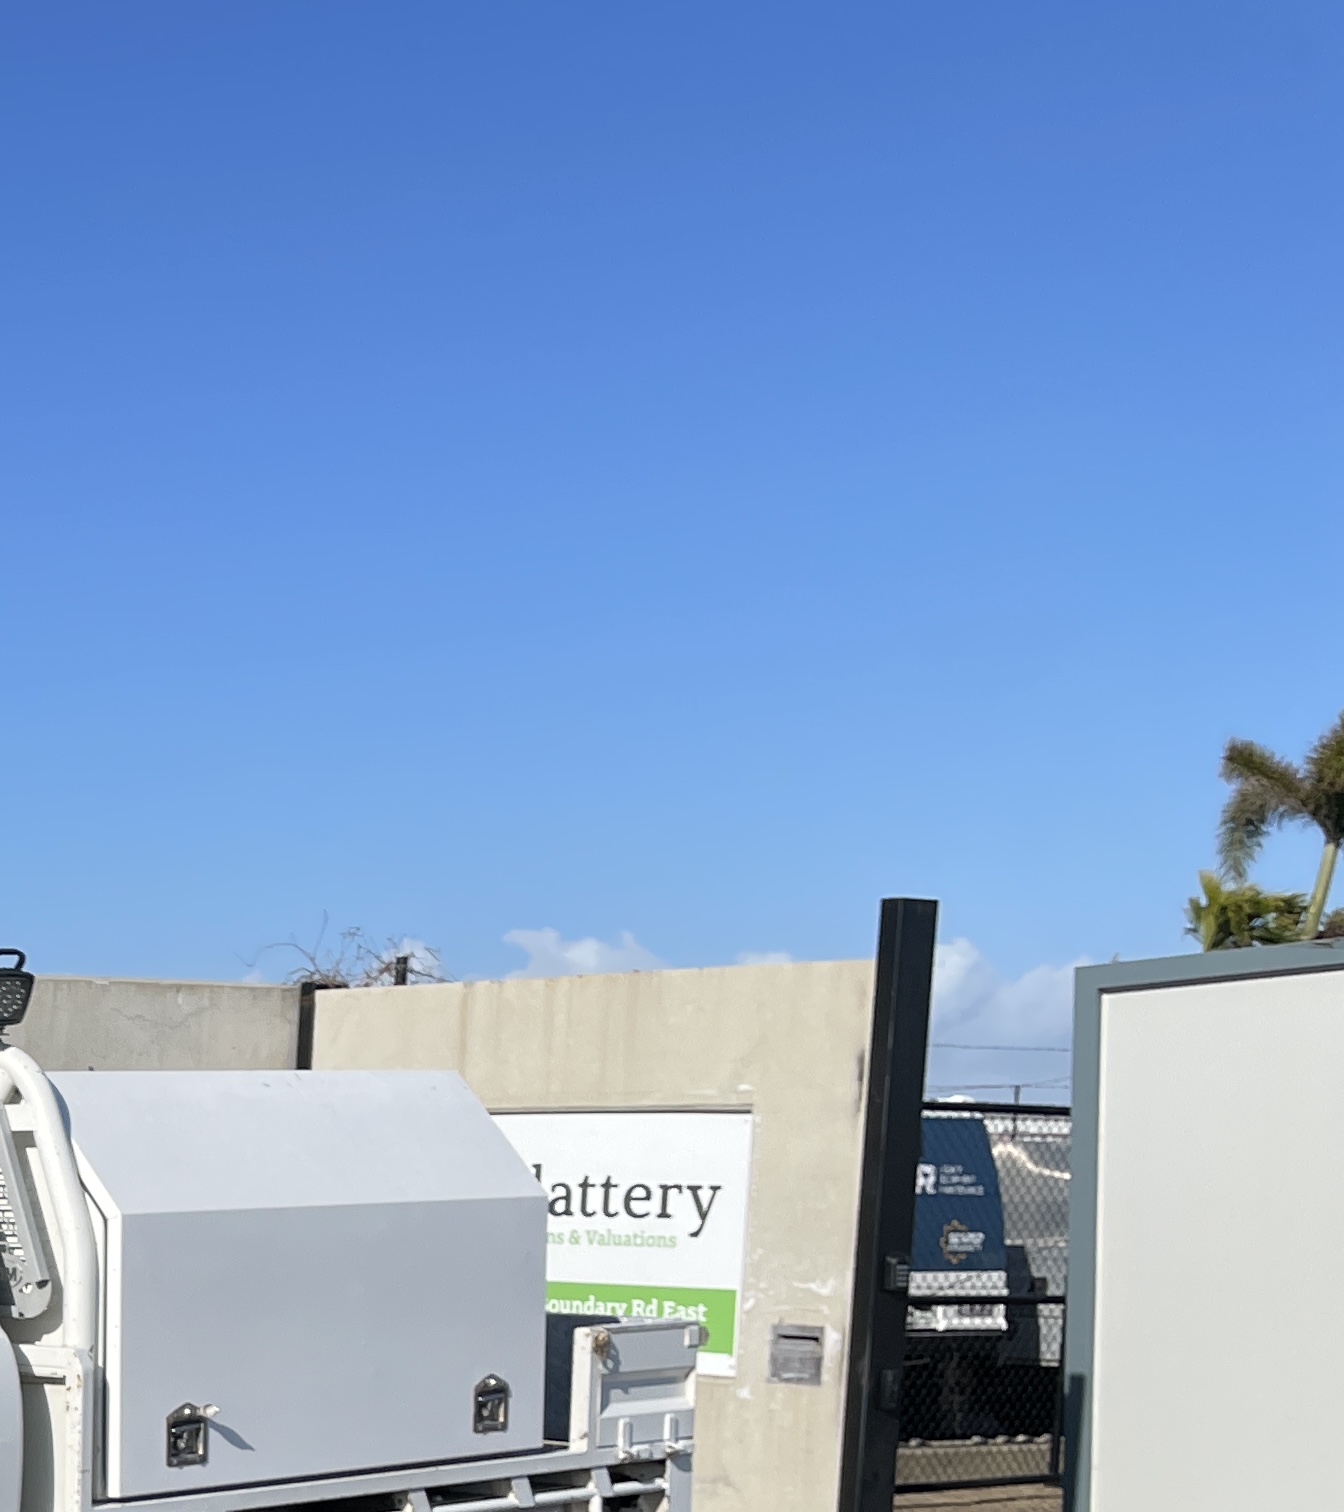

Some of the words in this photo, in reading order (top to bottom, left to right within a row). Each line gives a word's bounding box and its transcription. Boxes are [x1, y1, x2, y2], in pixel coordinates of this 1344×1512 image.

[533, 1163, 722, 1238] attery
[568, 1229, 582, 1246] &
[585, 1228, 677, 1249] Valuations
[545, 1295, 628, 1317] oundary
[631, 1298, 659, 1318] Rd
[663, 1300, 708, 1322] East
